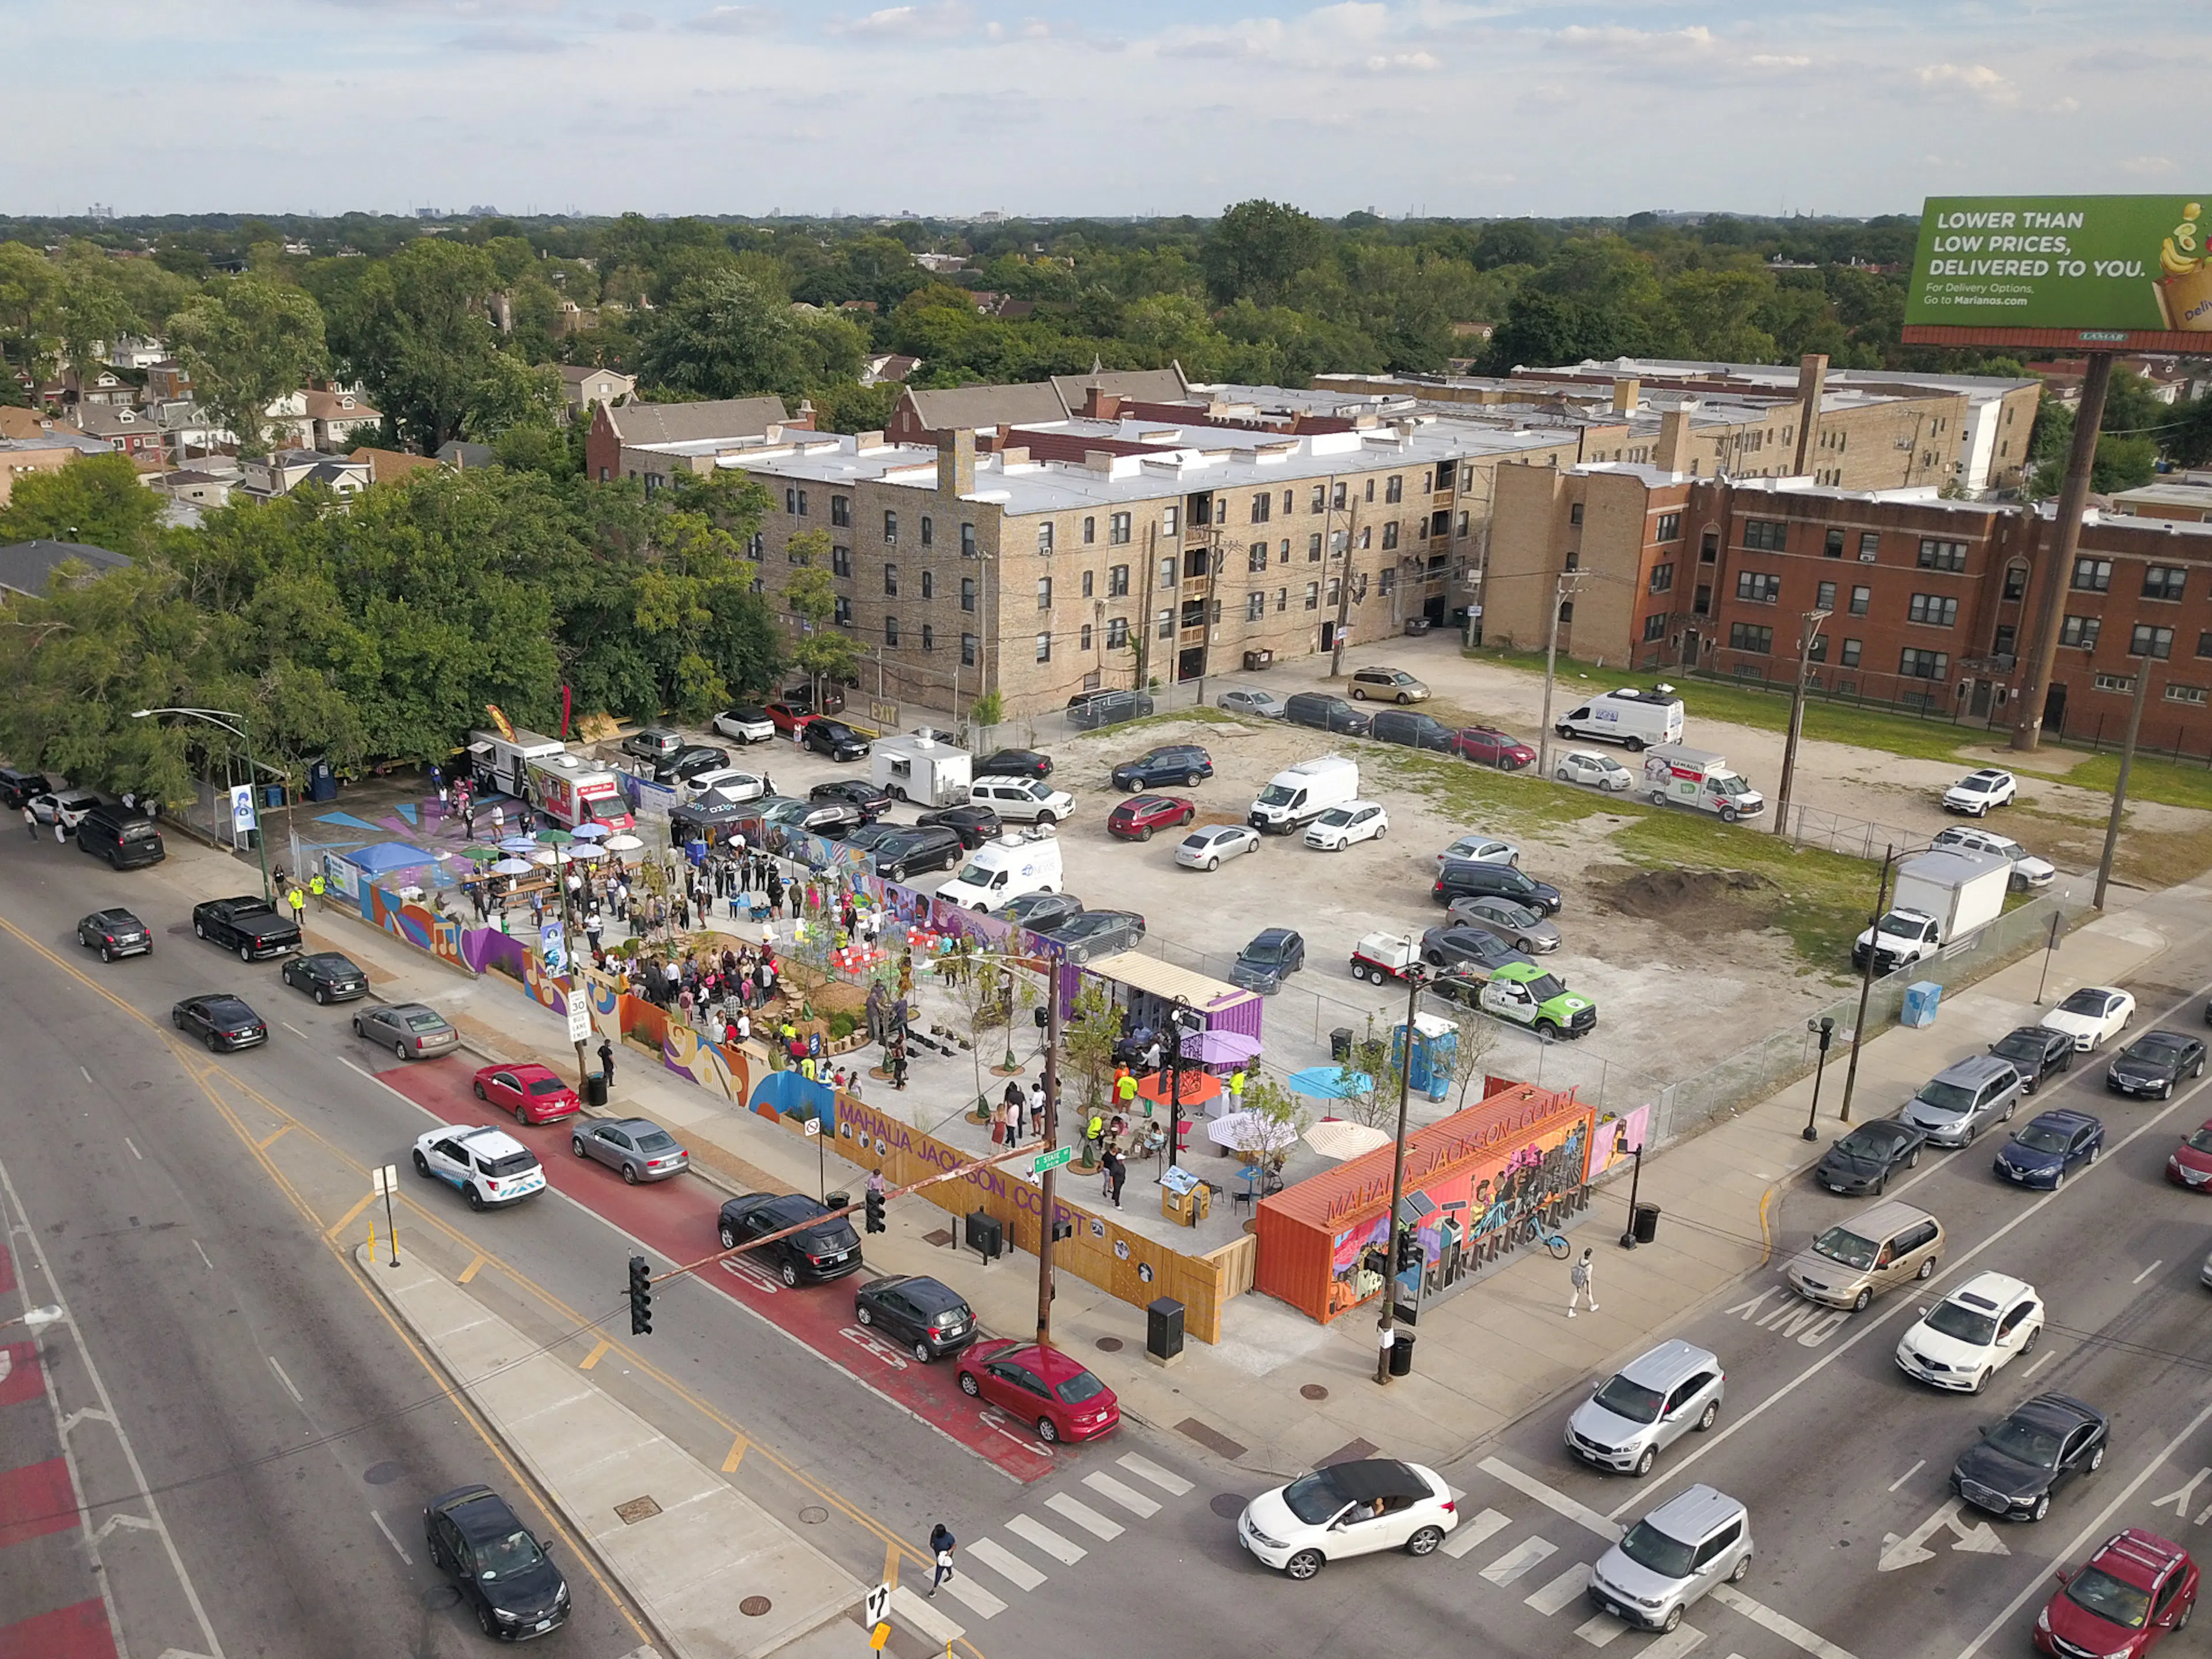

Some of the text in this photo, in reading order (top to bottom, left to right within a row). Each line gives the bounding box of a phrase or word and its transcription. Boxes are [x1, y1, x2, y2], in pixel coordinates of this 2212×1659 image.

[1937, 213, 2084, 229] LOWER THAN
[1934, 236, 2071, 256] LOW PRICES,
[1929, 260, 2146, 277] DELIVERED TO YOU.
[1926, 282, 2035, 294] For Delivery Options,
[1924, 296, 1938, 304] Go
[1954, 296, 2028, 305] Marianos.com
[871, 702, 896, 724] EXIT
[572, 1001, 585, 1012] 30
[573, 1014, 585, 1023] BUS
[573, 1022, 586, 1032] LANE
[573, 1029, 588, 1039] ENDS
[839, 1100, 913, 1153] MAHALIA
[1043, 1152, 1060, 1164] STATE
[1327, 1085, 1580, 1224] MAHALA JACKSON COURT
